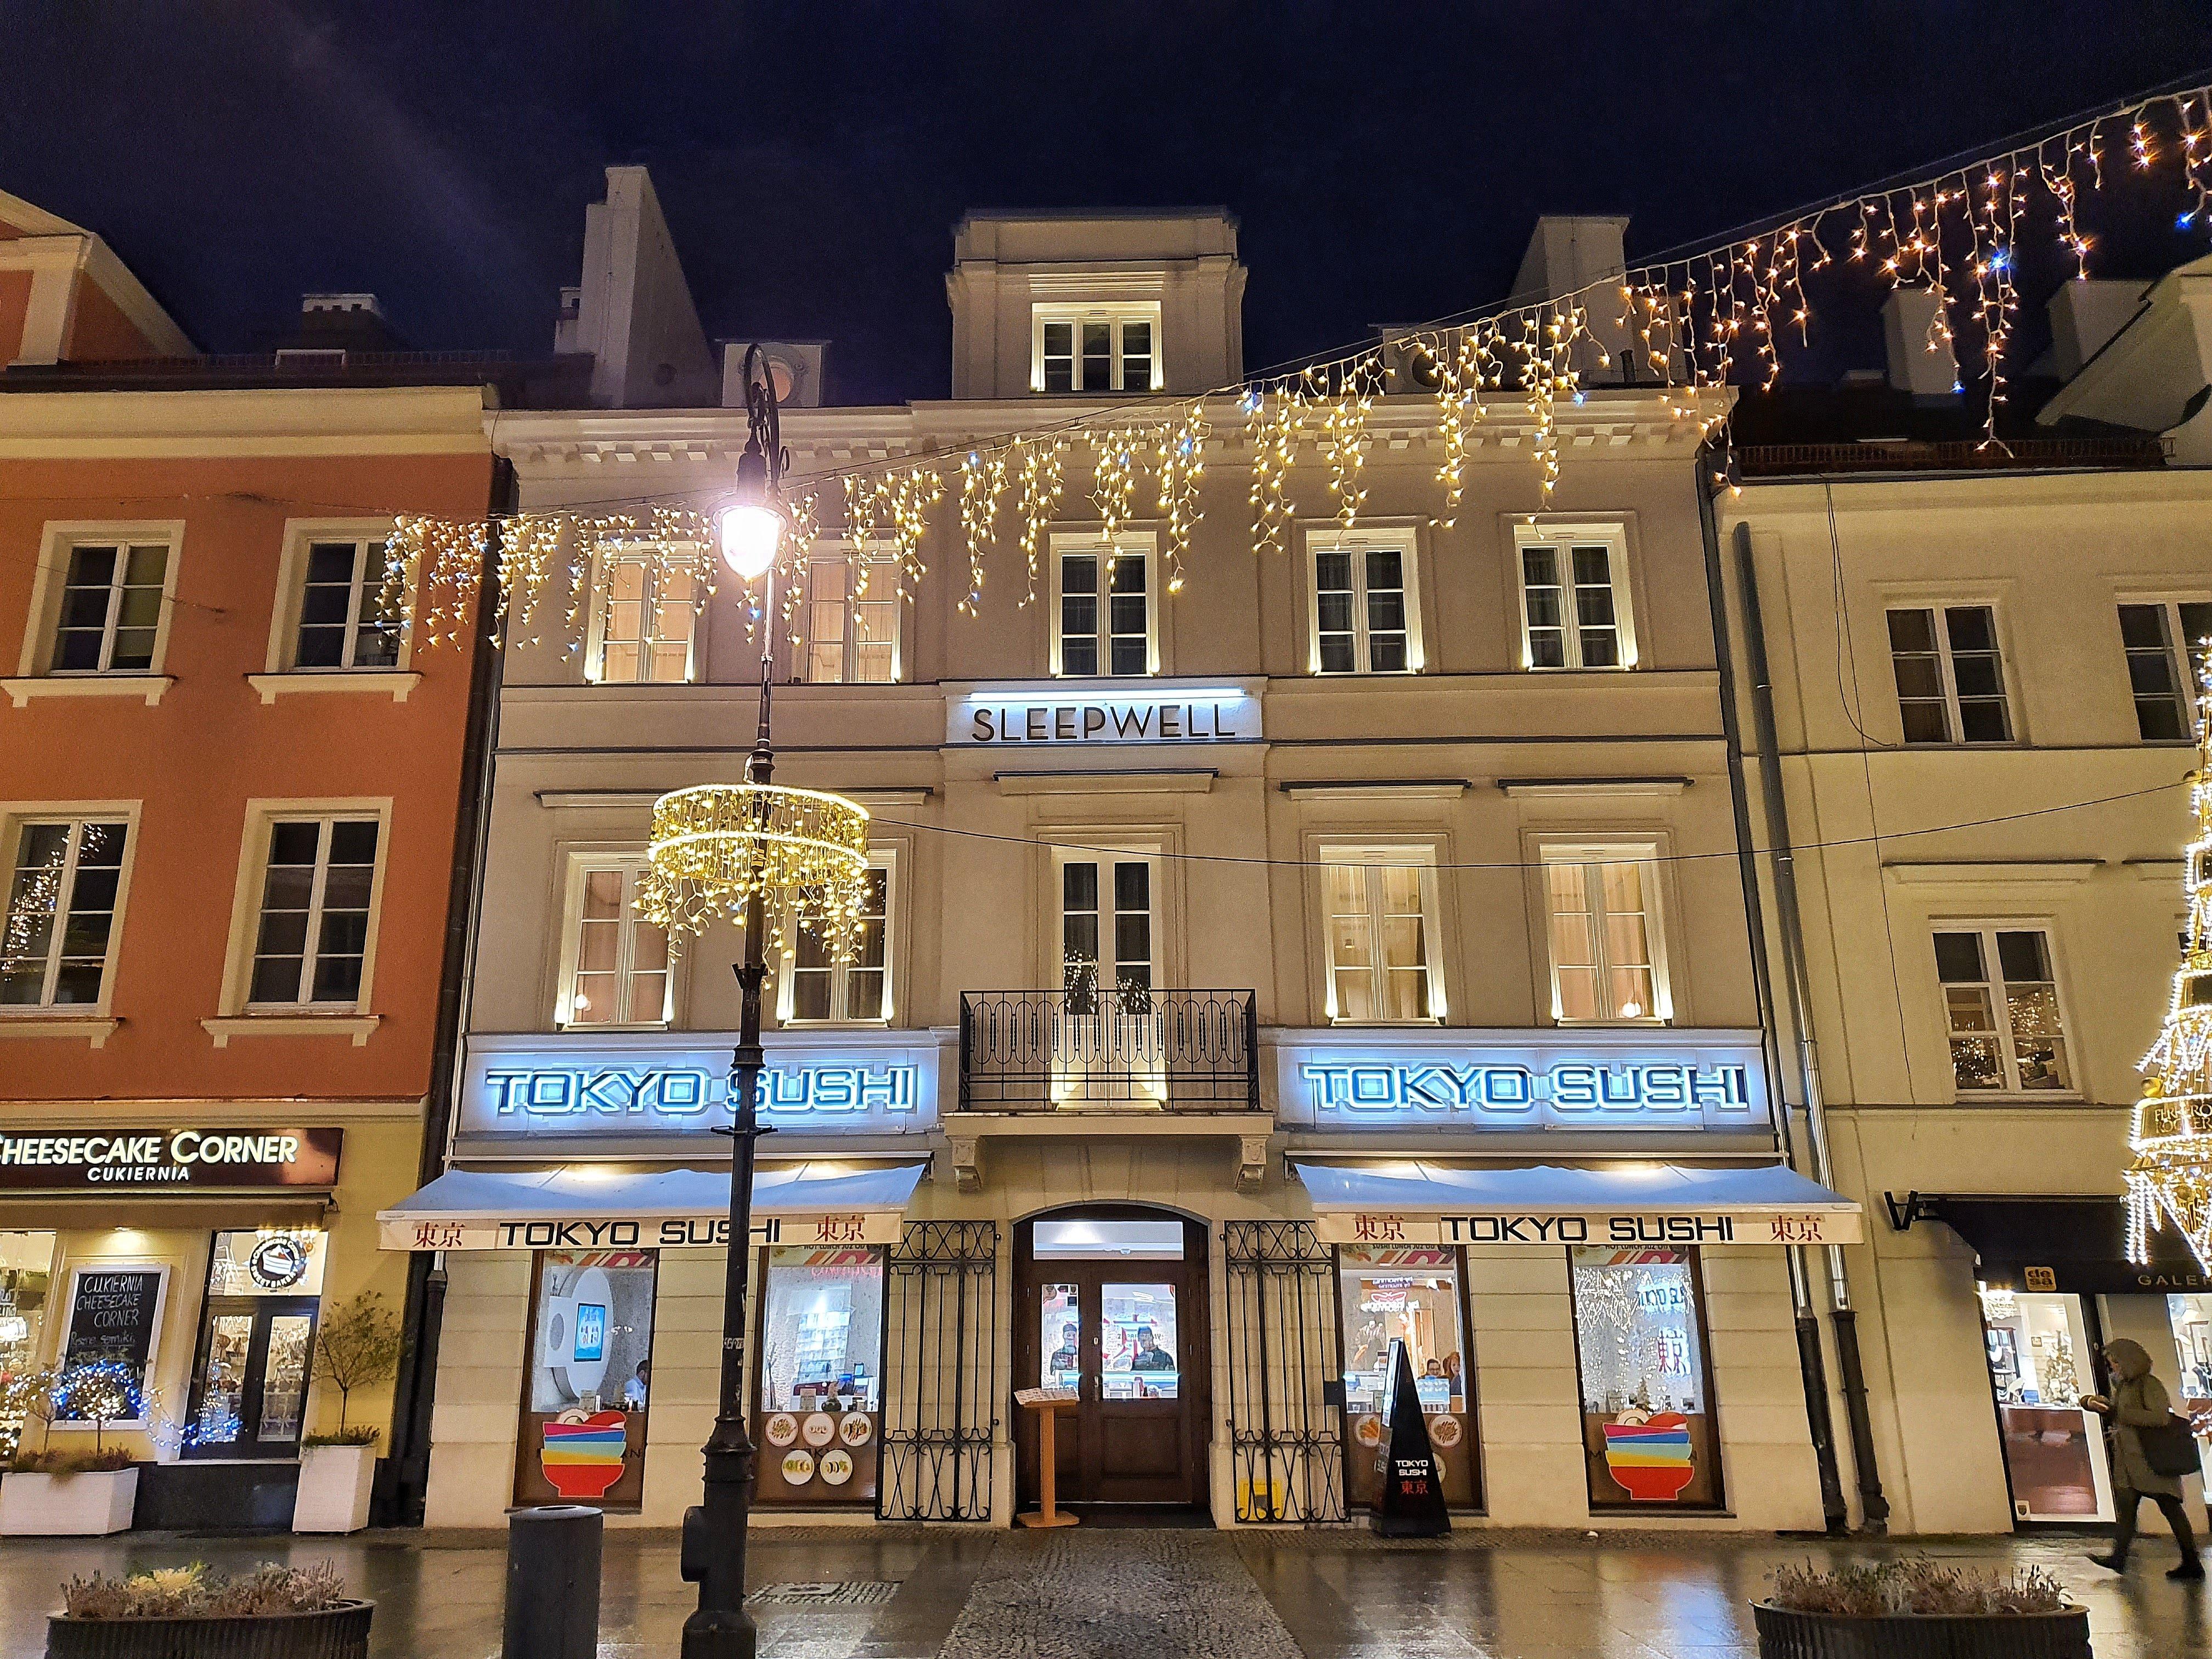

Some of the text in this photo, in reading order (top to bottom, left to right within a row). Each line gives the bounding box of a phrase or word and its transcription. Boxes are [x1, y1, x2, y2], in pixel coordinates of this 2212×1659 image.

[972, 704, 1235, 741] SLEEPWELL
[487, 1068, 914, 1113] TOKYO SUSHI
[1303, 1064, 1748, 1110] TOKYO SUSHI
[0, 1131, 300, 1164] HEESECAKE CORNER
[87, 1166, 190, 1181] CUKIERNIA
[414, 1222, 465, 1248] 東京
[499, 1221, 640, 1246] TOKYO
[814, 1215, 866, 1242] 東京
[1354, 1215, 1404, 1241] 東京
[1441, 1216, 1734, 1242] TOKYO SUSHI
[1771, 1216, 1822, 1242] 東京
[84, 1275, 143, 1293] CUKIERNIA
[77, 1294, 142, 1311] CHEESECAKE
[94, 1309, 139, 1327] CORNER
[1400, 1480, 1429, 1494] 東京
